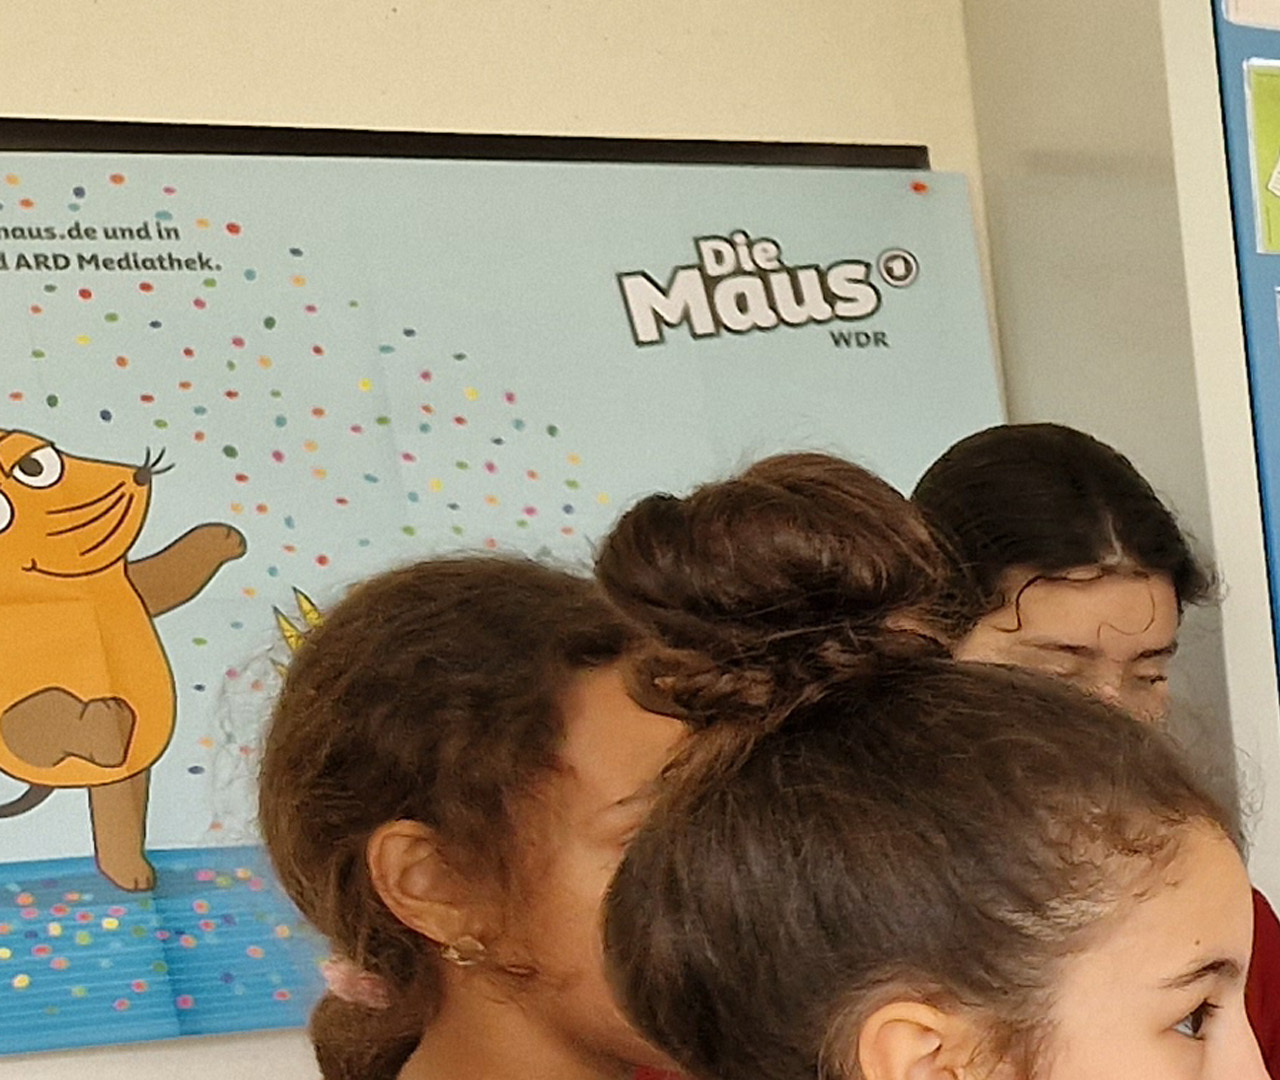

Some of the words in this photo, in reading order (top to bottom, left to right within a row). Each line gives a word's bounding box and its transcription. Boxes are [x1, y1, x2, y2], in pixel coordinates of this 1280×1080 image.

[104, 221, 151, 240] und
[156, 221, 180, 240] in
[15, 253, 71, 271] ARD
[77, 252, 222, 271] Mediathek.
[694, 229, 785, 276] Die
[616, 258, 882, 347] Maus
[830, 330, 889, 348] WDR
